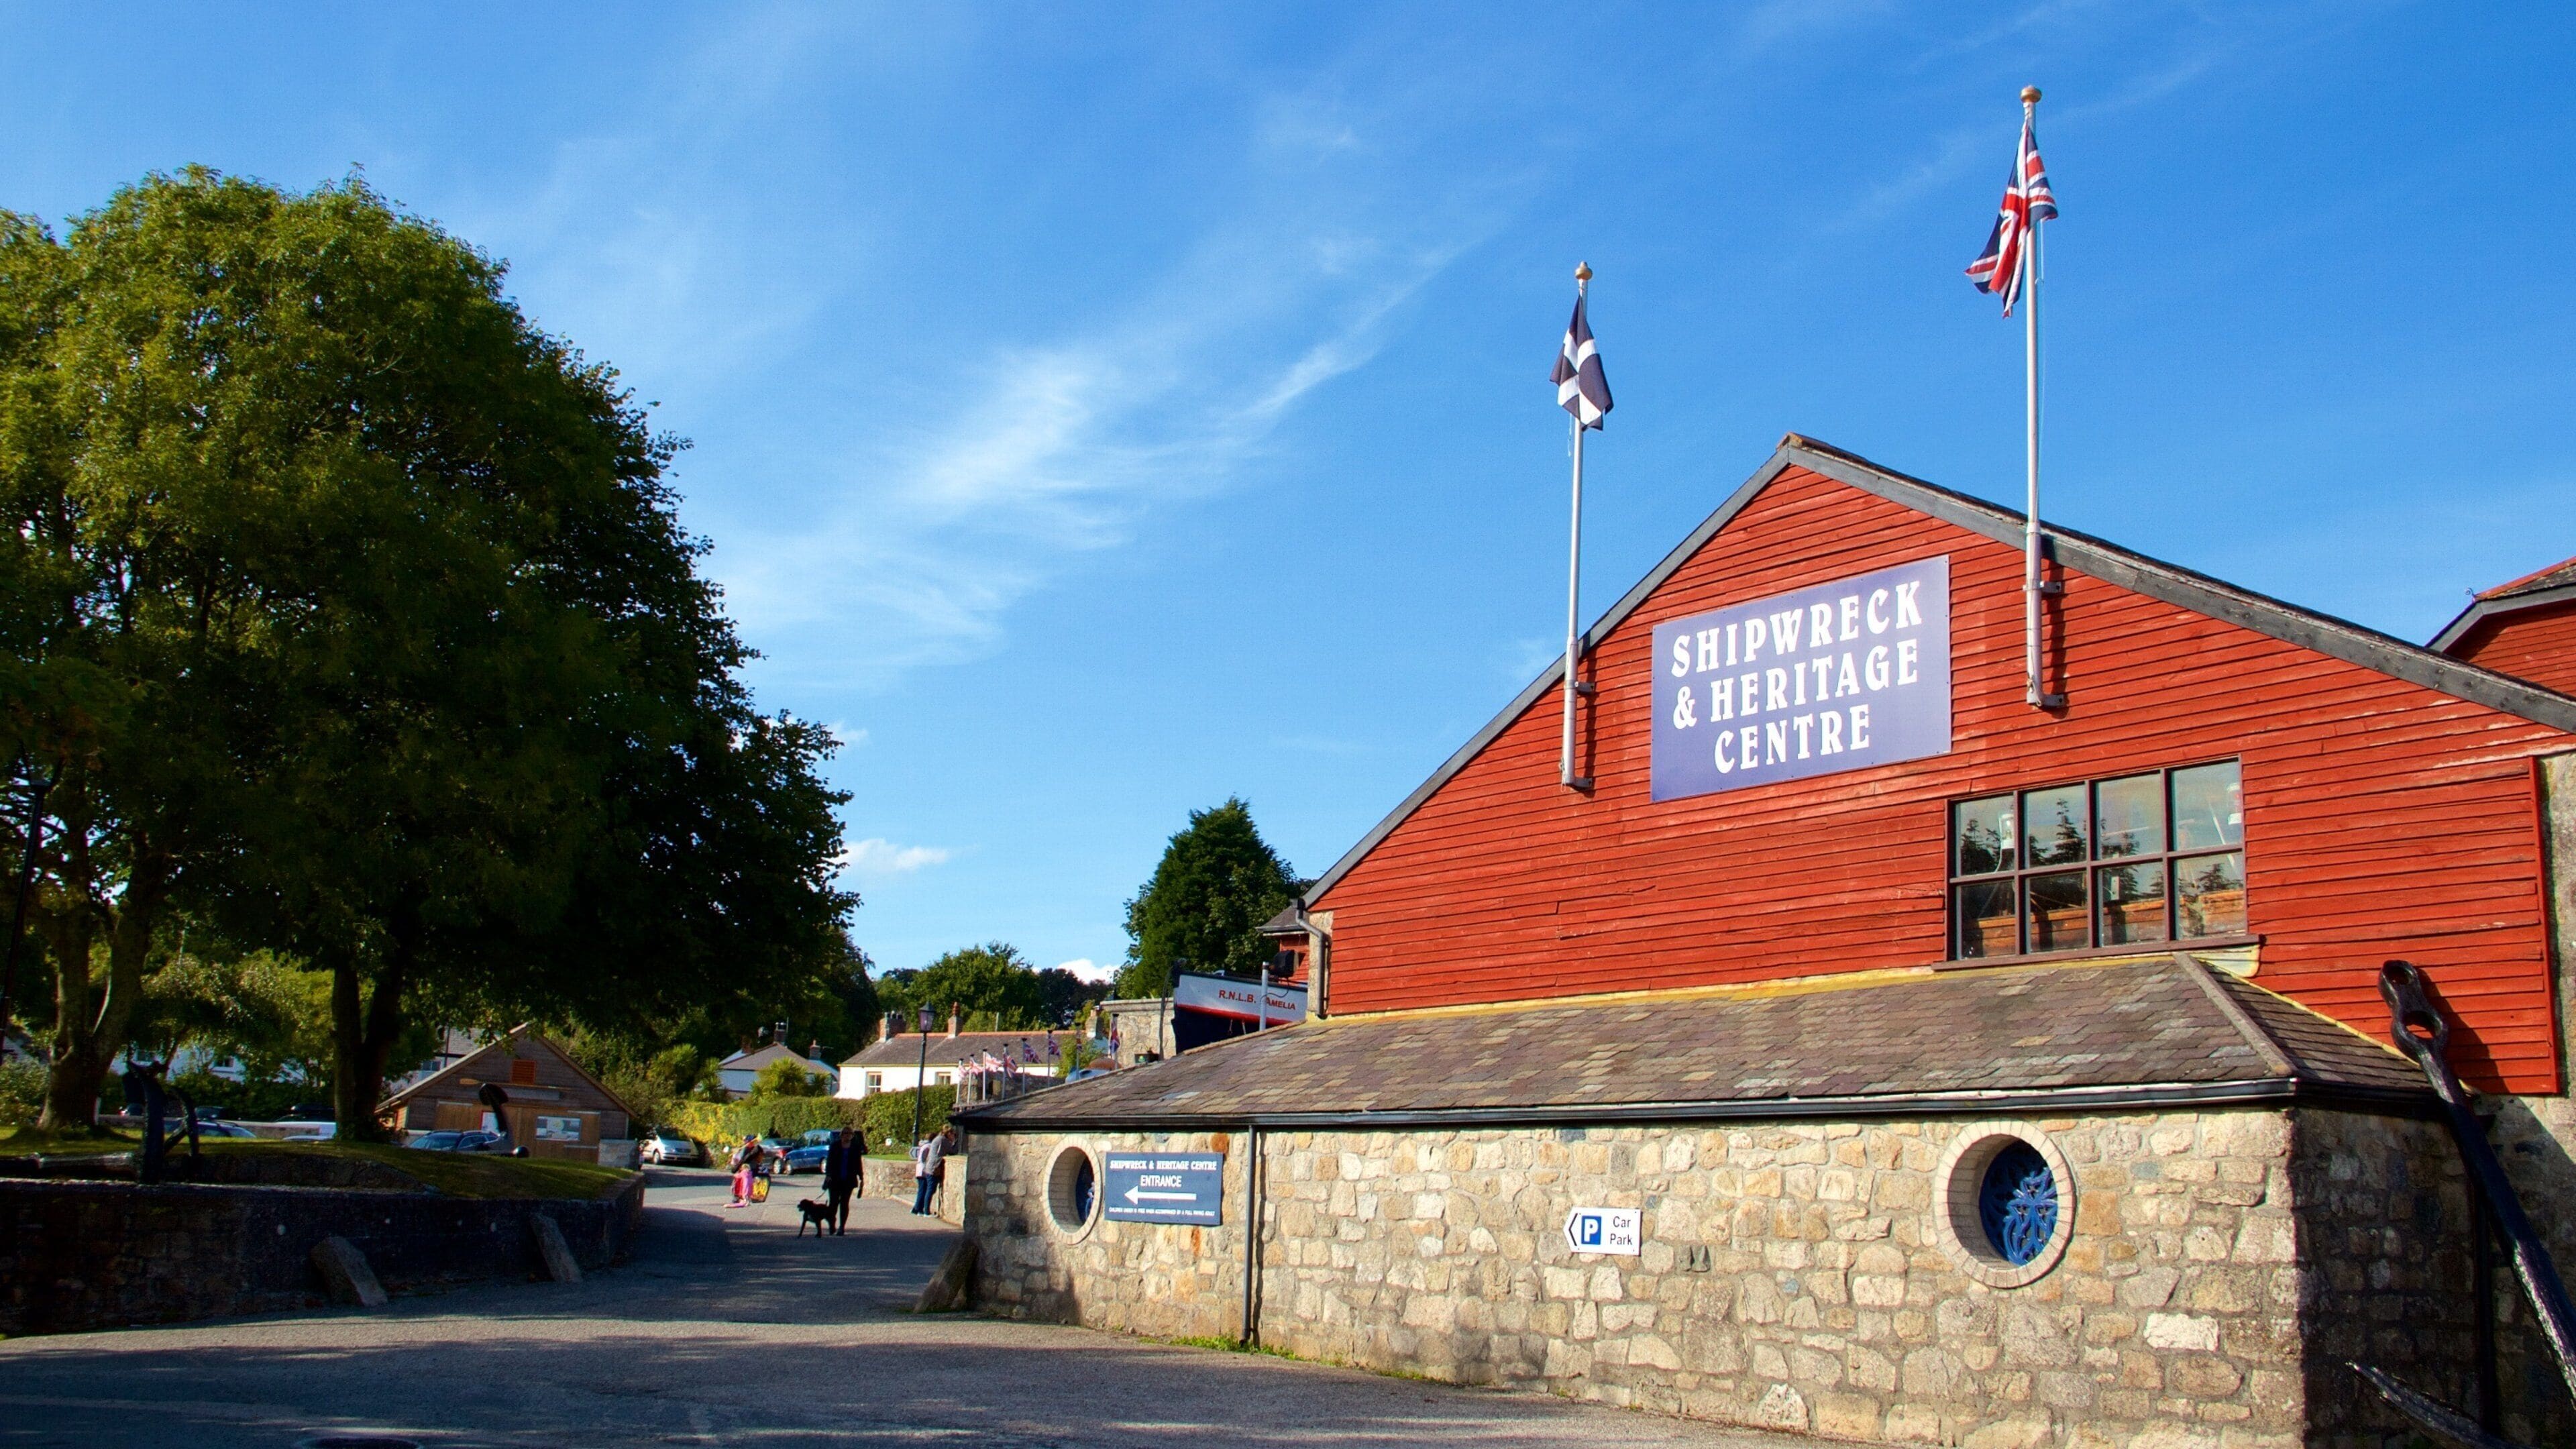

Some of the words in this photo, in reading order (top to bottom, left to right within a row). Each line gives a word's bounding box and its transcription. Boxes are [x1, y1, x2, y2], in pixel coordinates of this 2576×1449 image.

[1671, 580, 1923, 678] SHIPWRECK
[1672, 686, 1697, 729] &
[1710, 638, 1918, 722] HERITAGE
[1714, 704, 1870, 773] CENTRE
[1218, 989, 1256, 1004] R.N.L.B.
[1110, 1161, 1147, 1169] SHIPWRECK
[1148, 1161, 1155, 1170] &
[1157, 1161, 1189, 1170] HERITAGE
[1191, 1161, 1217, 1171] CENTRE
[1140, 1175, 1182, 1187] ENTRANCE
[1613, 1216, 1631, 1228] Car
[1584, 1218, 1599, 1242] P
[1610, 1233, 1633, 1245] Park
